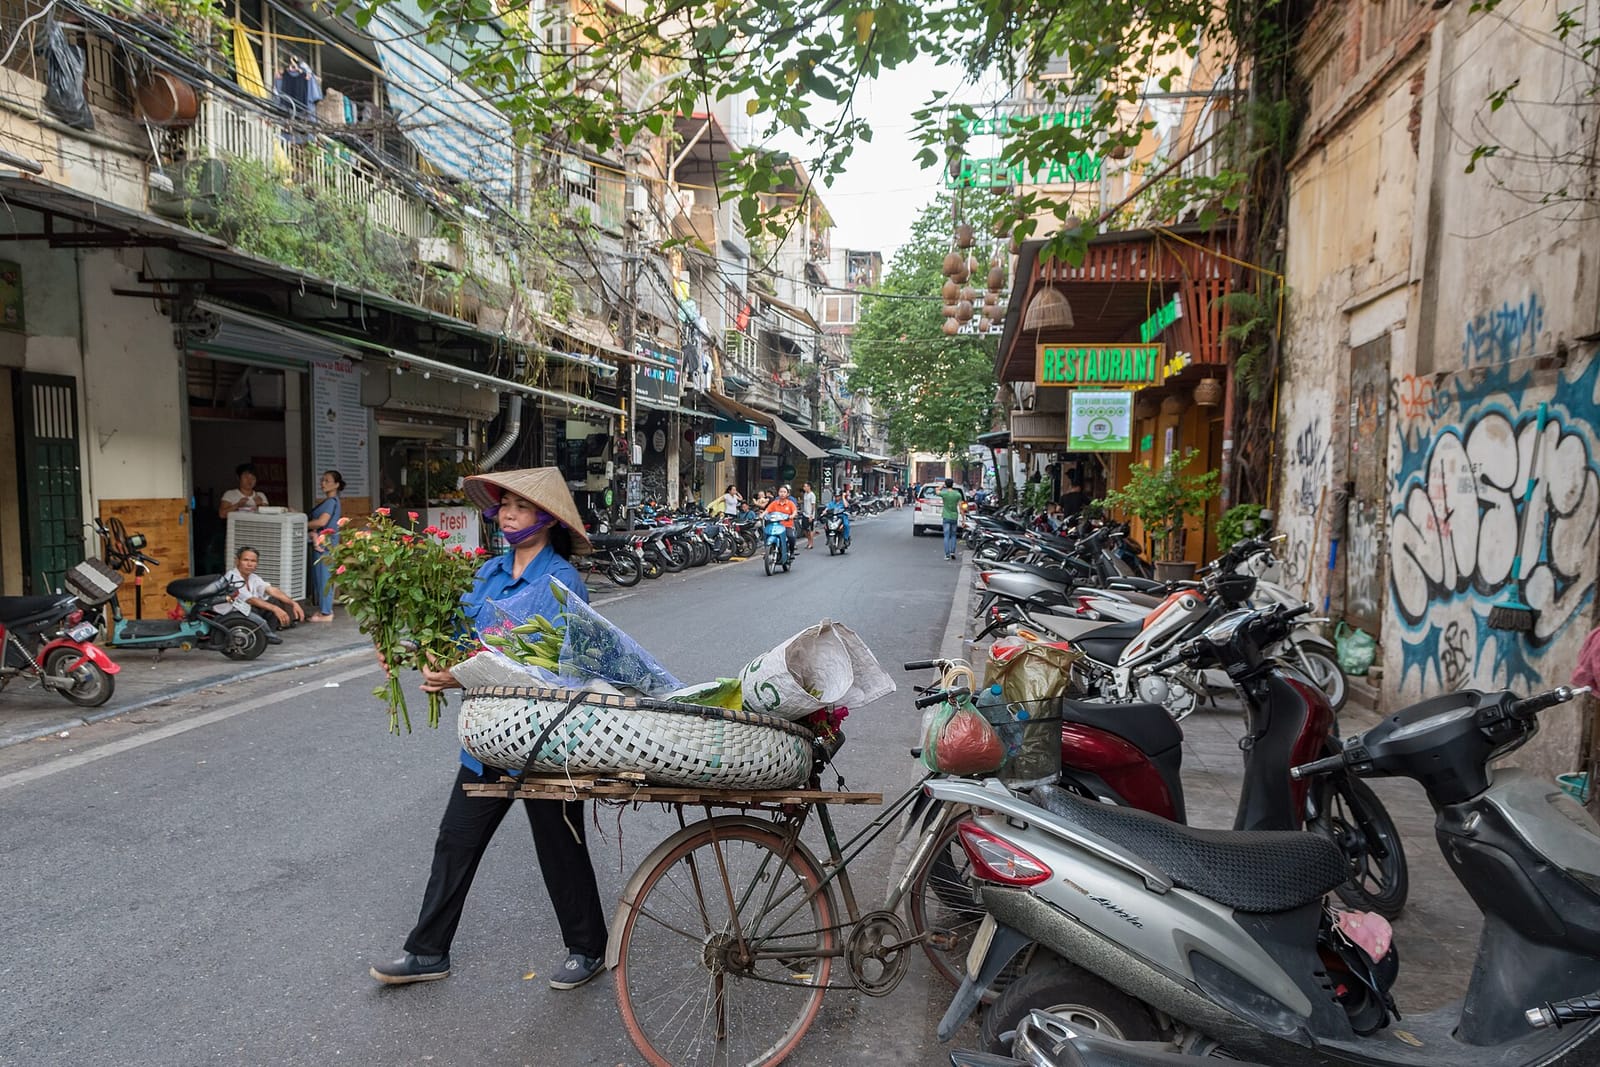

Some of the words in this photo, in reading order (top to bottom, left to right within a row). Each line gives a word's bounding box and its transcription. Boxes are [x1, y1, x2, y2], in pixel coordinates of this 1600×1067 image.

[1032, 151, 1102, 185] ARM
[1043, 347, 1159, 382] RESTAURANT
[733, 437, 758, 447] sushi
[440, 511, 467, 531] Fresh
